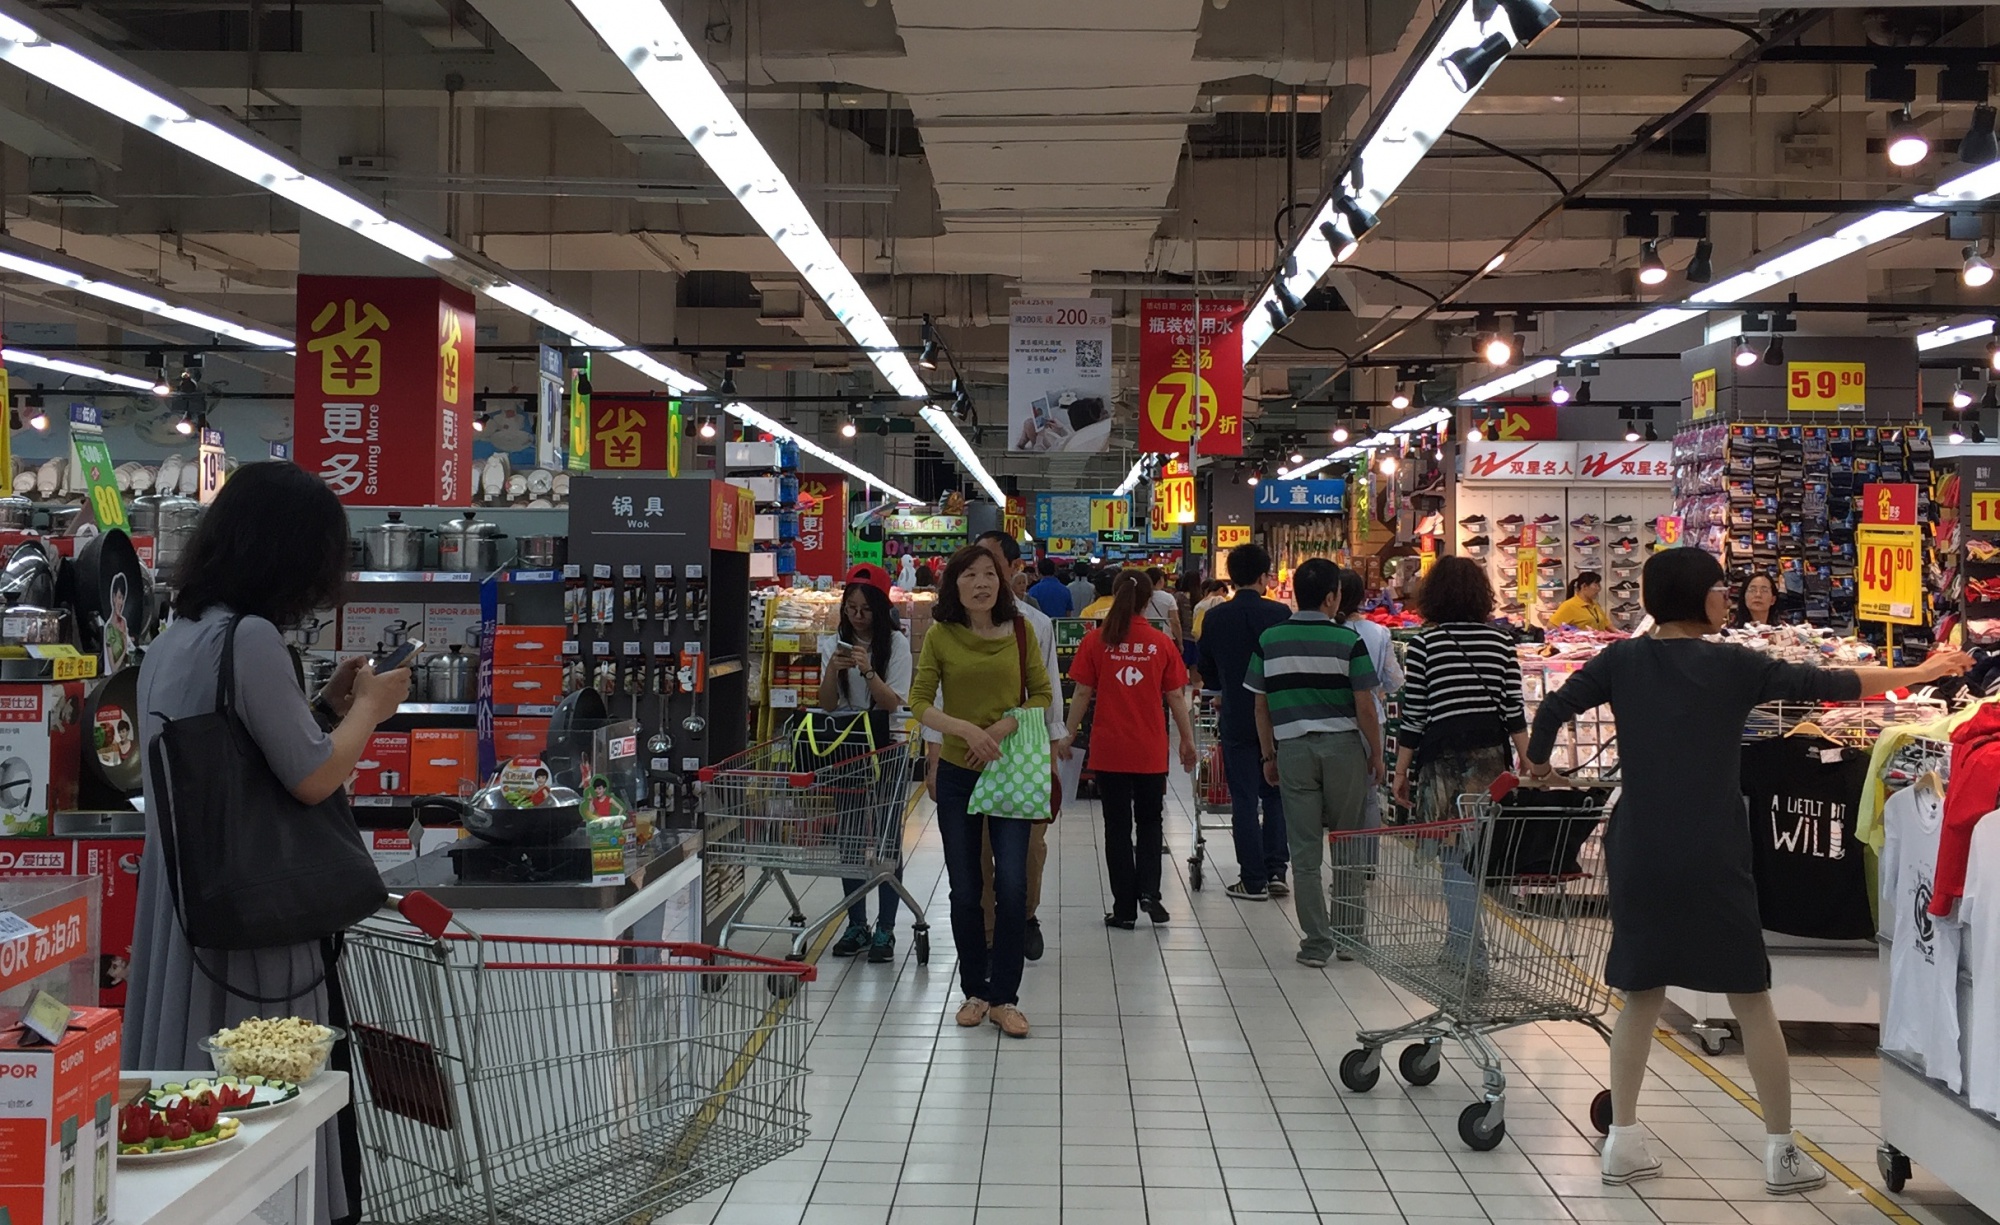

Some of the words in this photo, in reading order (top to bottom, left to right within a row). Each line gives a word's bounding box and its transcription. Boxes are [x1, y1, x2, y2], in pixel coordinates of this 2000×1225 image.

[1056, 308, 1088, 325] 200
[1149, 316, 1234, 335] 瓶装饮用水
[365, 403, 381, 441] More
[364, 445, 382, 496] Saving
[1510, 460, 1574, 475] 双星名人
[1165, 481, 1193, 514] 119
[1260, 484, 1309, 505] 儿童
[1313, 494, 1340, 504] Kids
[611, 496, 665, 517] 锅具
[627, 518, 651, 529] Wok
[347, 607, 377, 615] SUPOR
[429, 608, 459, 616] SUPOR
[1771, 794, 1779, 811] A
[22, 854, 62, 867] 爱仕达
[94, 1030, 117, 1054] SUPOR
[60, 1049, 85, 1074] SUPOR
